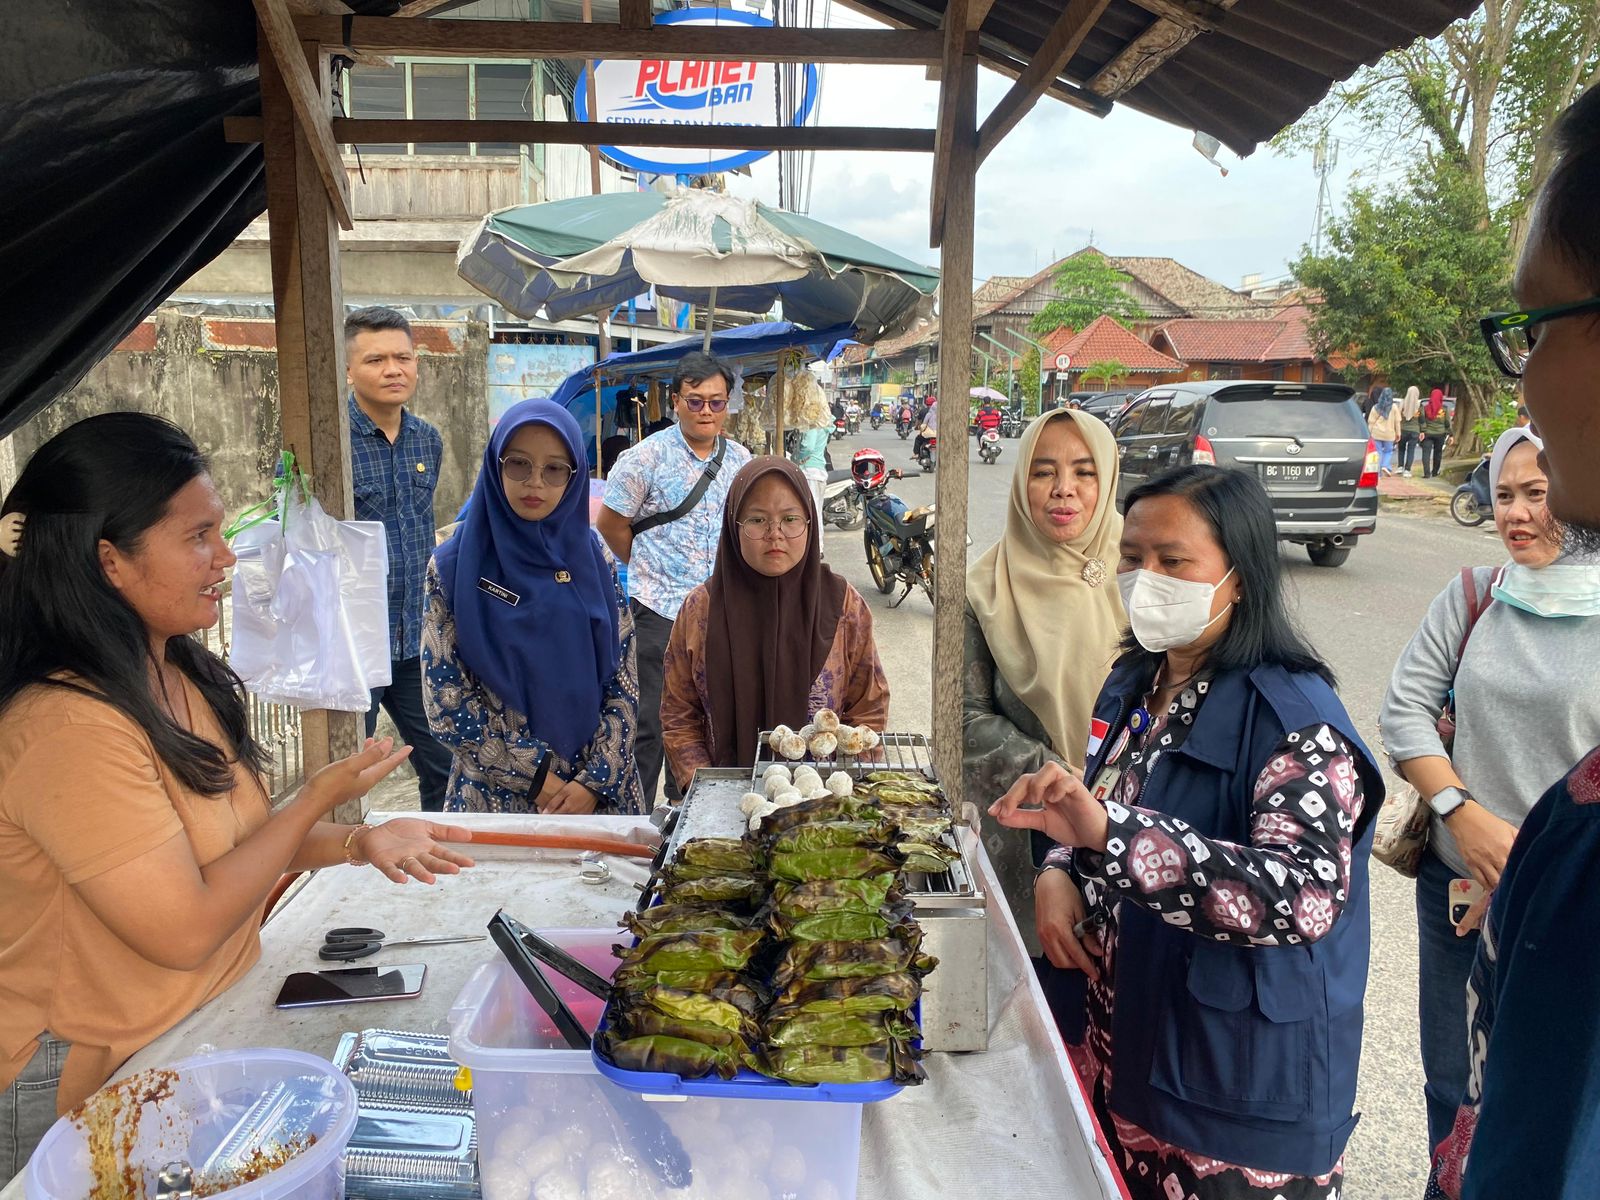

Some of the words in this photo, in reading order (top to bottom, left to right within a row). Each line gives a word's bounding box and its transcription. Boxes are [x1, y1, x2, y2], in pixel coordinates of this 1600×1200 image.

[708, 83, 753, 107] BAN
[1282, 465, 1301, 476] 1160
[1305, 465, 1316, 476] KP
